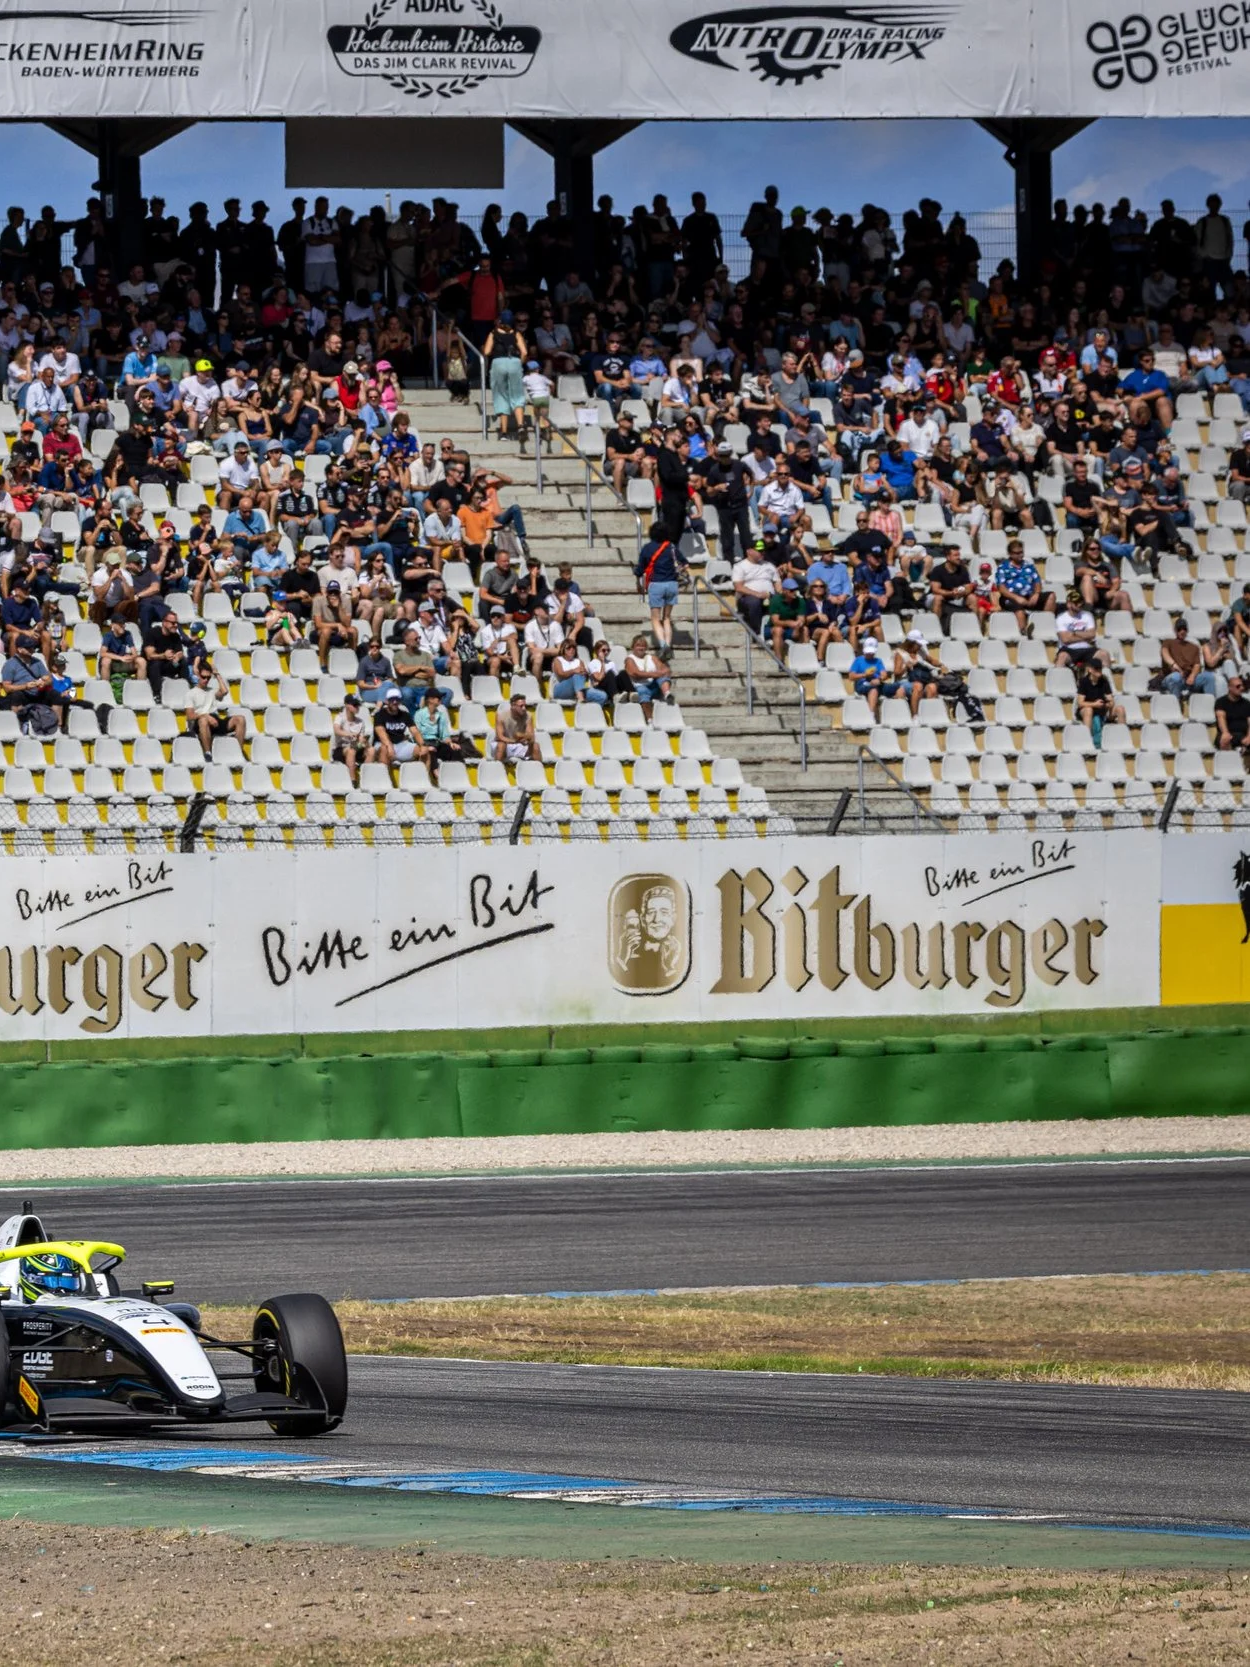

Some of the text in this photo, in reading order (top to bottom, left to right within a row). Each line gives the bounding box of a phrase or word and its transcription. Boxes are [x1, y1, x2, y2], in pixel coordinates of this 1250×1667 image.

[404, 0, 464, 13] ADAC
[344, 27, 524, 52] Hockenheim Historic
[826, 28, 946, 40] DRAG RACING
[354, 57, 516, 70] DAS JIM CLARK REVIVAL
[1167, 57, 1232, 77] FESTIVAL
[925, 838, 1076, 897] Bitte ein Bit
[16, 860, 173, 920] Bitte ein Bit
[262, 869, 555, 986] Bitte ein Bit
[708, 864, 1108, 1007] Bitburger
[23, 1321, 53, 1330] PROSPERITY
